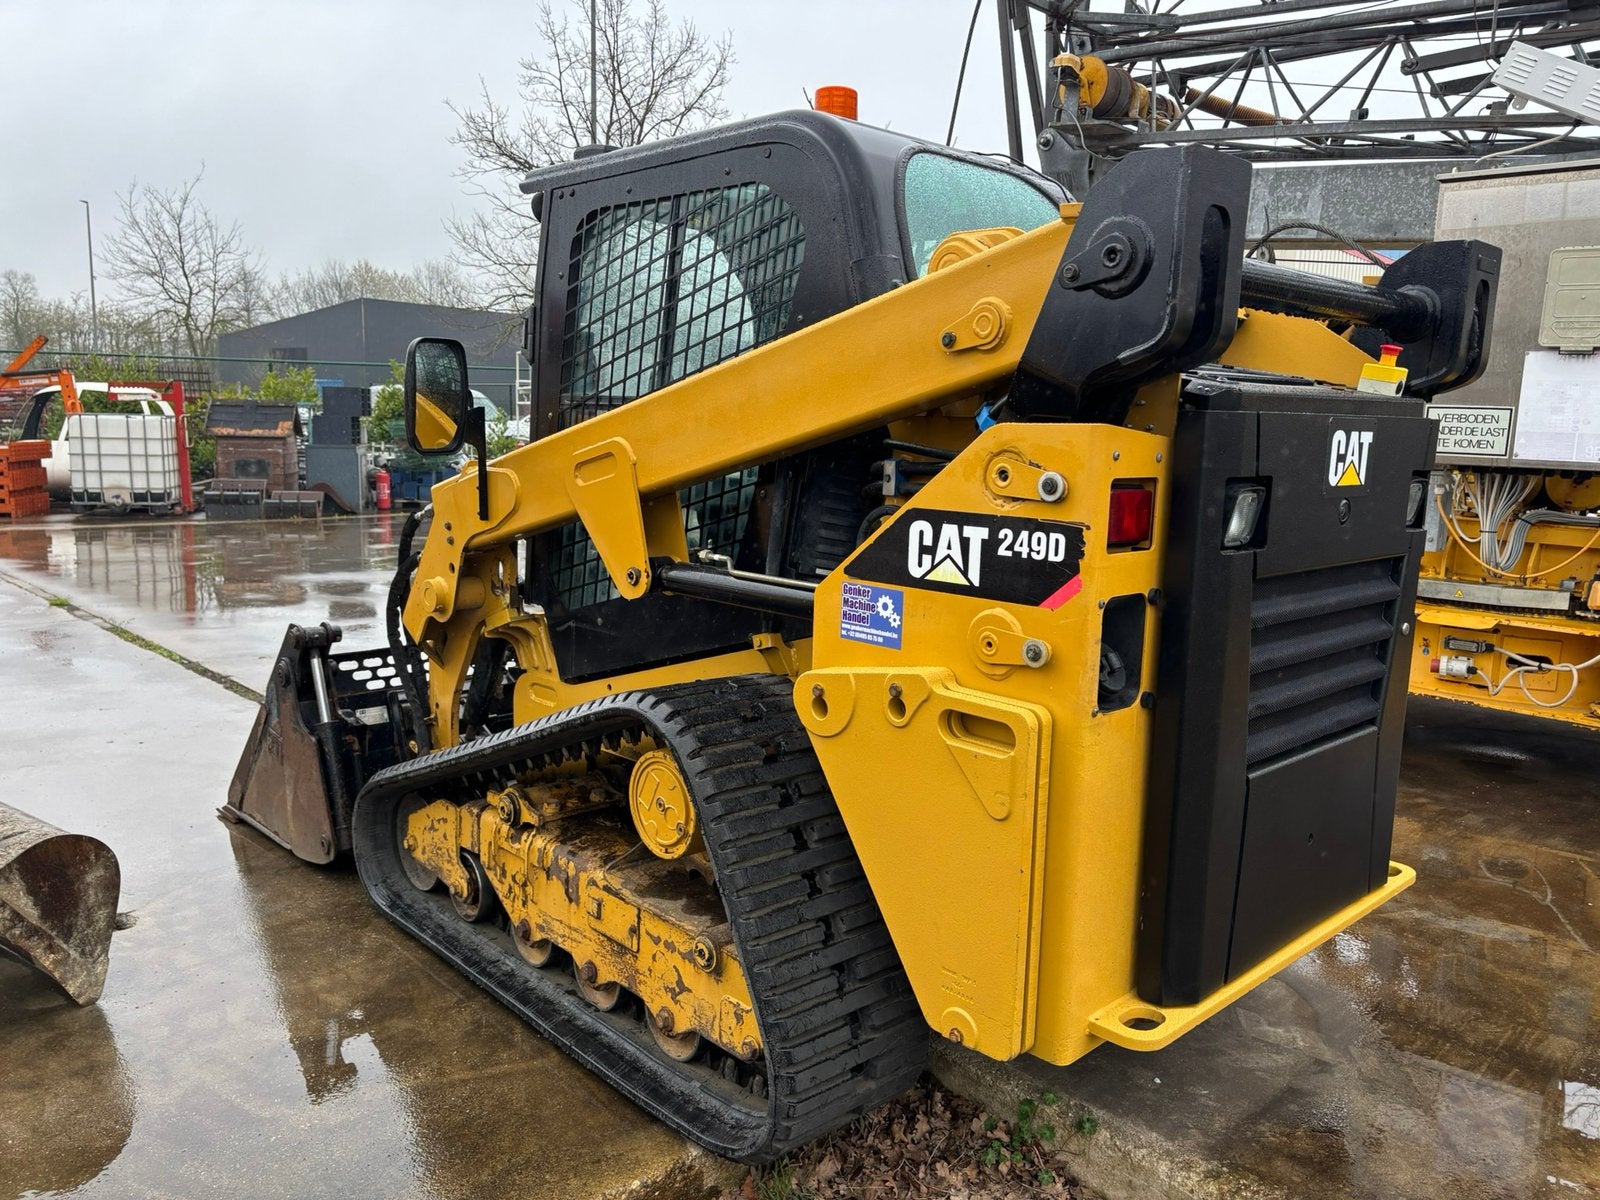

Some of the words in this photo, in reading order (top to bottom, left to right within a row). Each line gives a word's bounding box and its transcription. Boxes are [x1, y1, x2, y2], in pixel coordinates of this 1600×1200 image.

[1437, 413, 1500, 424] VERBODEN
[1438, 425, 1464, 436] NDER
[1464, 426, 1479, 436] DE
[1480, 427, 1507, 438] LAST
[1437, 438, 1450, 447] TE
[1453, 439, 1495, 449] KOMEN
[1329, 429, 1374, 487] CAT
[907, 519, 989, 587] CAT
[997, 528, 1066, 563] 249D
[843, 583, 871, 598] Genker
[843, 597, 876, 613] Machine
[843, 611, 869, 625] Handel
